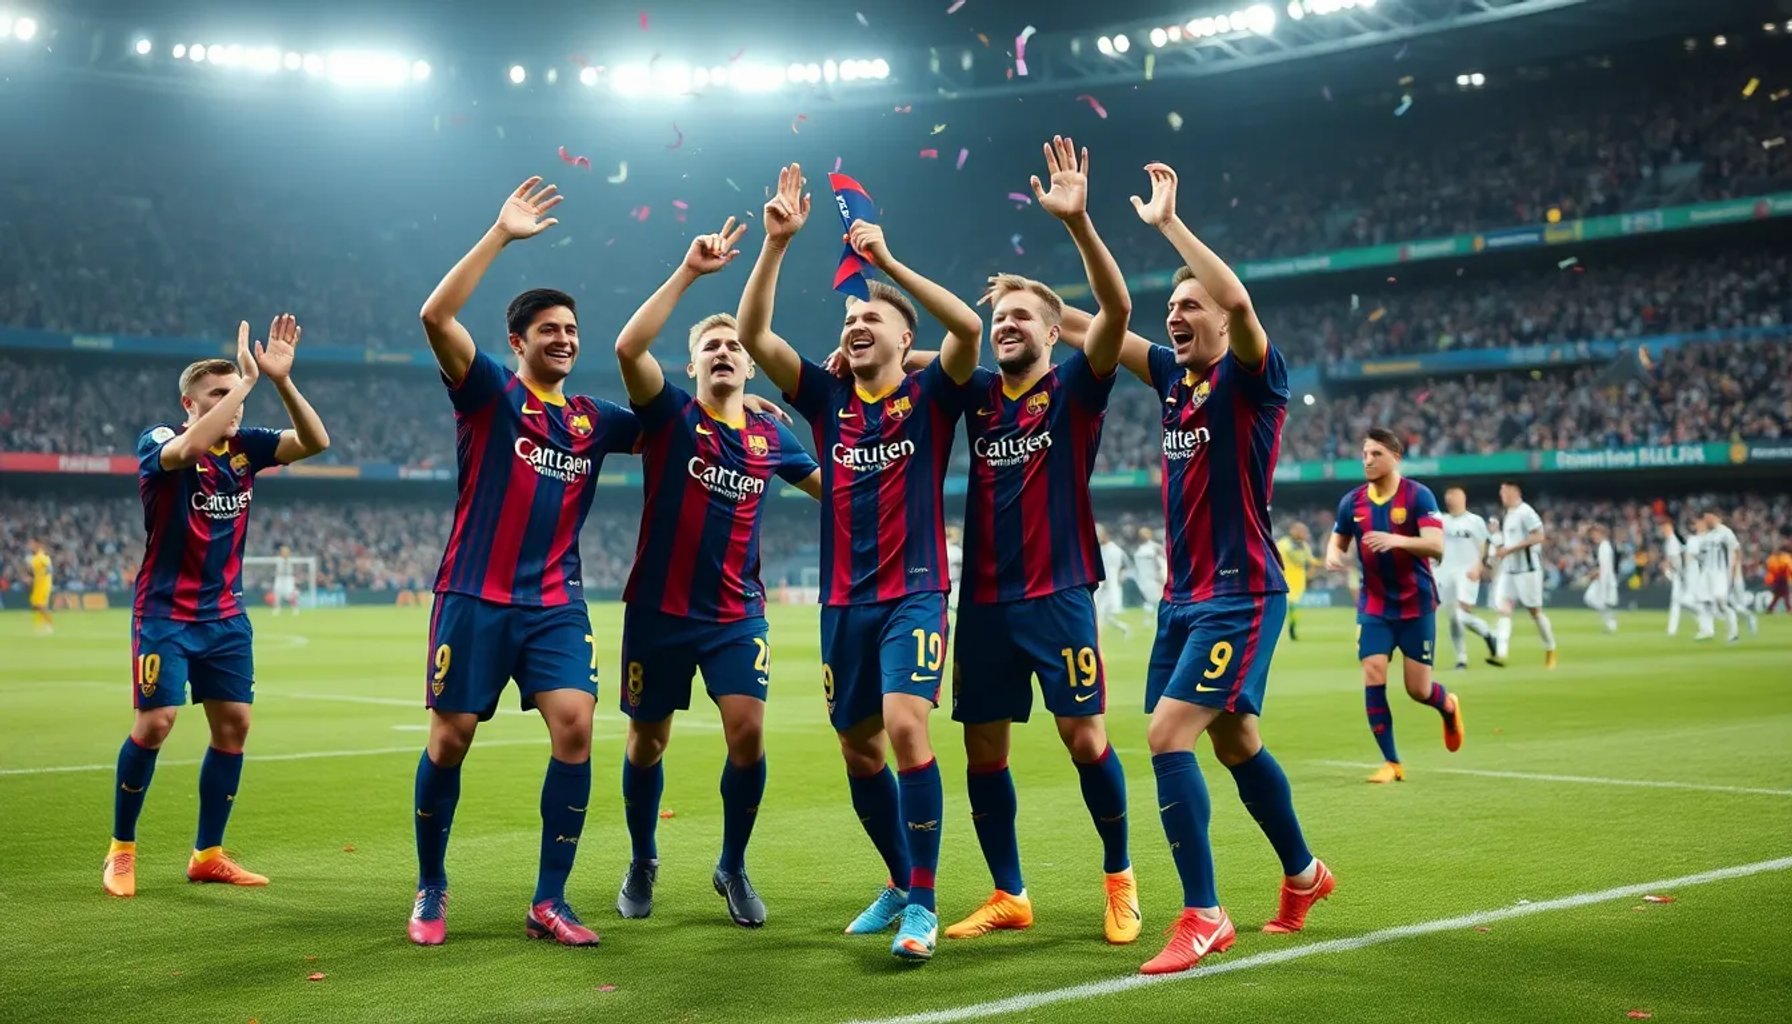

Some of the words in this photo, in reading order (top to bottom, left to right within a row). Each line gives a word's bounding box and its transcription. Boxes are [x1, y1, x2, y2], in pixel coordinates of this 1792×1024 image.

[434, 643, 452, 681] 9
[1061, 646, 1097, 687] 19
[1203, 641, 1233, 679] 9
